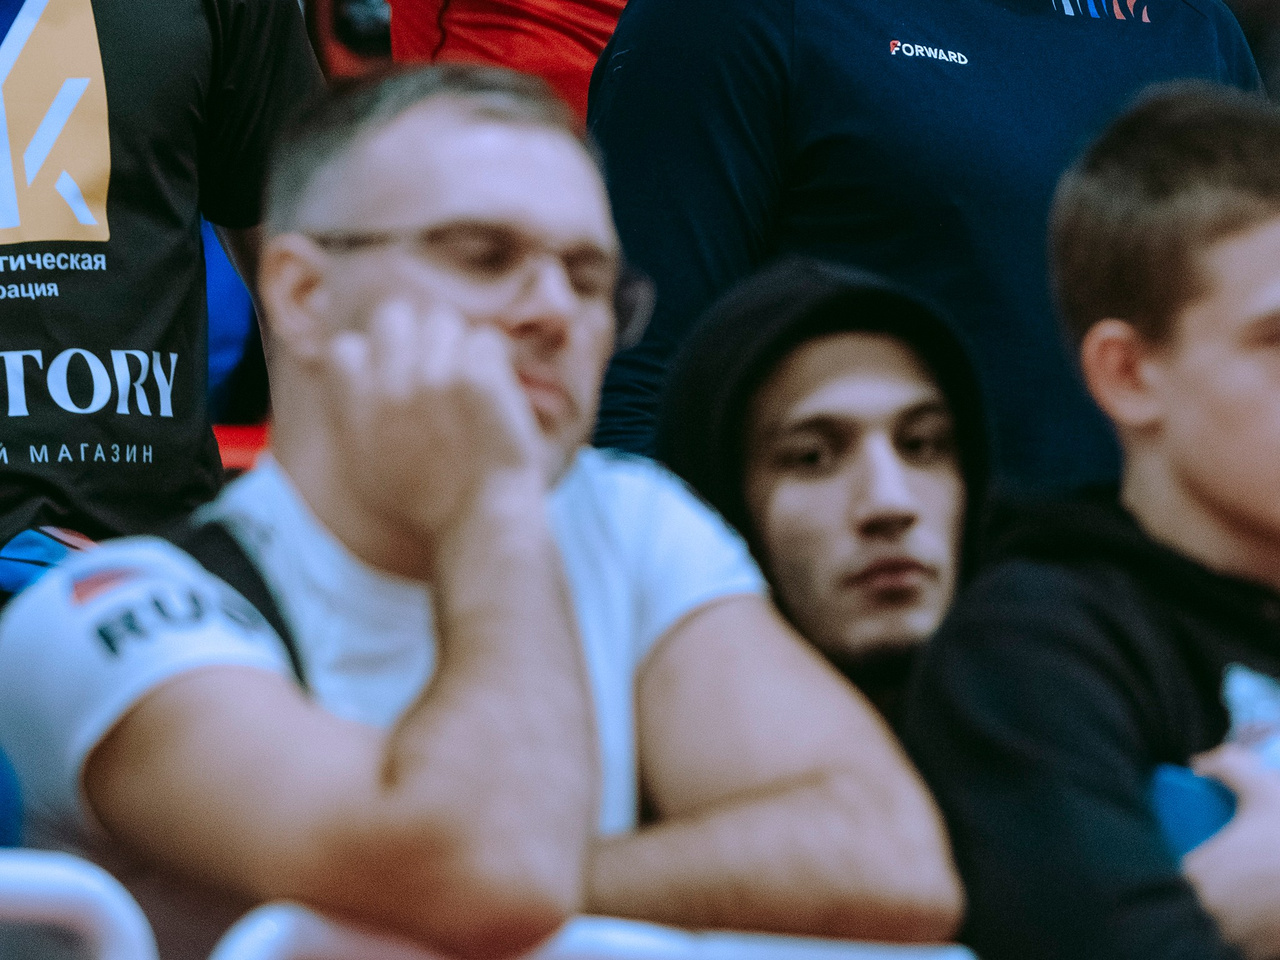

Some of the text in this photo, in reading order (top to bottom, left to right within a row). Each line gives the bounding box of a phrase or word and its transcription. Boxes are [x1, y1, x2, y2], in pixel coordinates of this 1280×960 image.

[889, 39, 969, 65] FORWARD
[0, 347, 179, 418] TORY
[29, 442, 153, 464] МАГАЗИН
